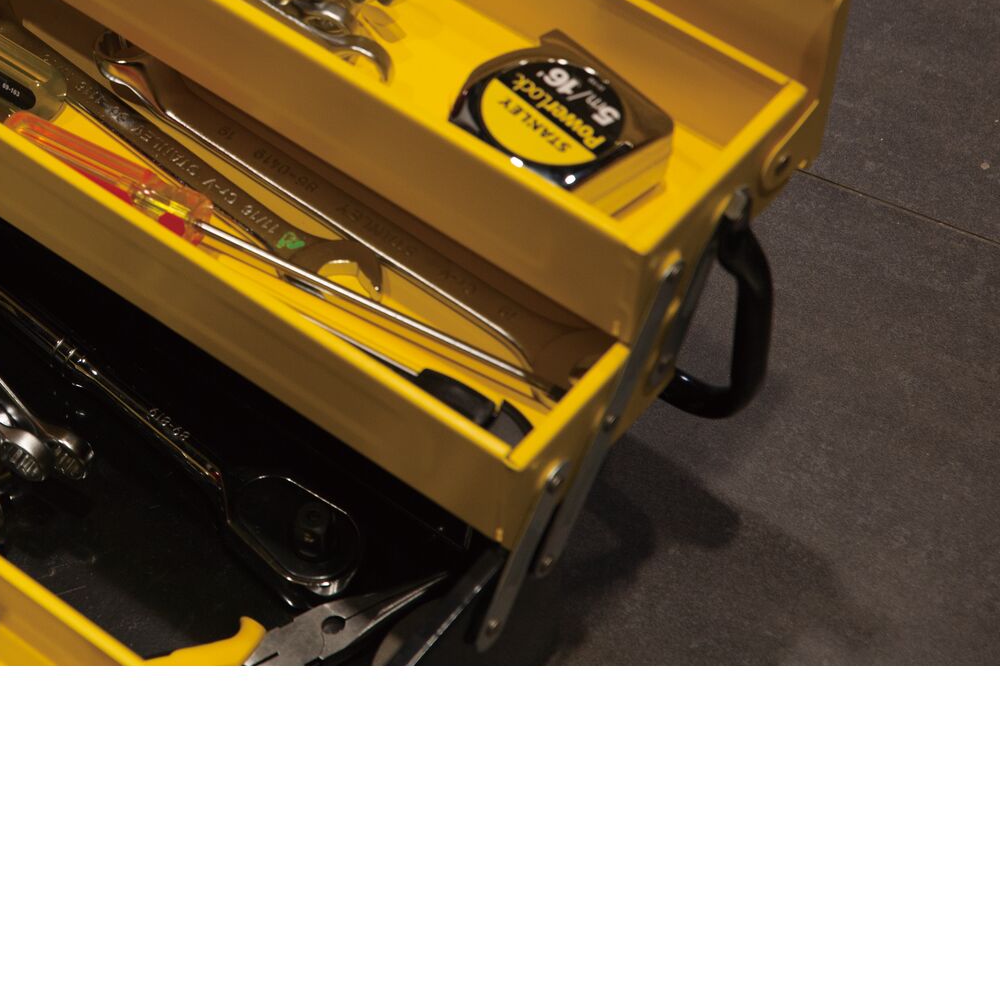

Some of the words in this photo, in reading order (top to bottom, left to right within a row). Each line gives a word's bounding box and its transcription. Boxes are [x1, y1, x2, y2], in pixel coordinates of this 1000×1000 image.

[498, 98, 574, 152] STANLEY
[201, 177, 238, 206] Cr-V
[241, 204, 280, 235] 11/16
